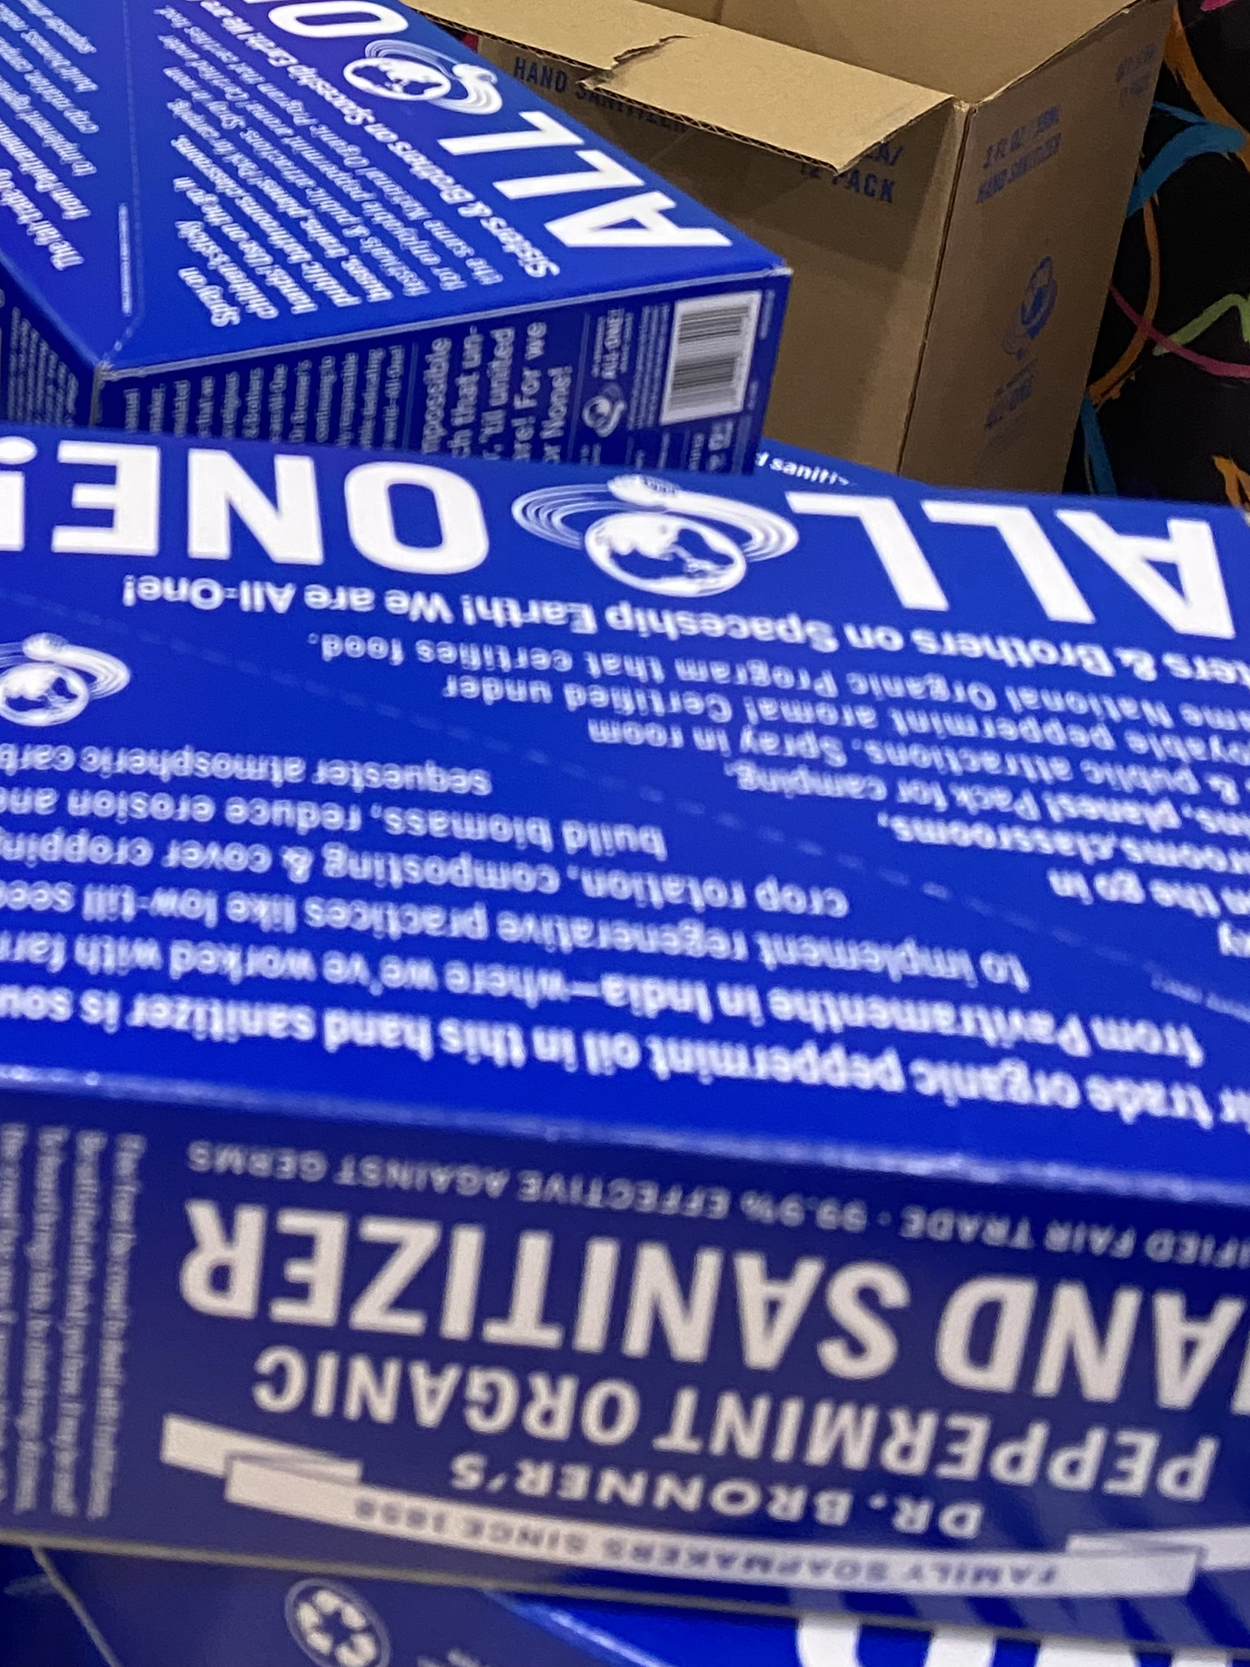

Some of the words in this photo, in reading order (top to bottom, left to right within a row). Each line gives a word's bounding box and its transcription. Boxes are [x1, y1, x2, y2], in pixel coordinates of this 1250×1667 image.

[200, 0, 233, 18] are
[221, 17, 260, 34] We
[237, 32, 298, 66] Earth!
[287, 65, 375, 125] Spaceship
[513, 56, 567, 94] HAND
[364, 124, 398, 142] on
[387, 141, 475, 204] Brothers
[438, 111, 732, 247] ALL
[458, 202, 492, 217] &
[480, 217, 560, 277] Sisters
[421, 338, 452, 454] mpossible
[786, 494, 1236, 640] ALL
[123, 575, 296, 613] All-One!
[304, 585, 375, 611] are
[385, 590, 453, 623] We
[462, 595, 597, 634] Earth!
[605, 601, 839, 652] Spaceship
[844, 624, 904, 651] on
[310, 633, 404, 665] food.
[416, 640, 573, 684] certifies
[585, 652, 665, 686] that
[911, 629, 1115, 676] Brothers
[1112, 648, 1157, 681] &
[444, 675, 552, 705] under
[675, 660, 838, 704] Program
[847, 673, 997, 714] Organic
[563, 684, 732, 723] Certified
[744, 698, 877, 732] aroma!
[1005, 687, 1173, 728] National
[588, 711, 684, 748] room
[693, 719, 730, 757] in
[735, 722, 847, 769] Spray
[890, 708, 1120, 750] peppermint
[80, 746, 306, 788] atmospheric
[312, 760, 492, 795] sequester
[852, 740, 1073, 784] attractions.
[1080, 759, 1201, 801] public
[67, 790, 215, 824] erosion
[1206, 775, 1239, 805] &
[225, 797, 362, 844] reduce
[371, 805, 553, 852] biomass,
[562, 820, 667, 861] build
[163, 840, 272, 873] cover
[281, 847, 314, 883] &
[322, 843, 560, 903] composting
[567, 866, 746, 912] rotation,
[755, 876, 849, 917] crop
[1048, 862, 1095, 905] in
[1091, 863, 1145, 903] go
[1149, 879, 1223, 917] the
[82, 884, 218, 928] low-till
[226, 892, 296, 933] like
[304, 897, 489, 940] practices
[74, 935, 163, 975] with
[497, 911, 748, 960] regenerative
[169, 940, 316, 984] worked
[323, 951, 438, 995] we've
[755, 933, 978, 988] implement
[977, 952, 1029, 992] to
[80, 990, 120, 1033] is
[445, 961, 712, 1023] India—where
[717, 984, 764, 1026] in
[126, 994, 316, 1042] sanitizer
[323, 1008, 433, 1061] hand
[767, 988, 1093, 1057] Pavitramenthe
[438, 1018, 526, 1068] this
[532, 1027, 577, 1072] in
[583, 1031, 641, 1075] oil
[1087, 1017, 1204, 1067] from
[646, 1036, 906, 1092] peppermint
[909, 1058, 1081, 1109] organic
[1085, 1075, 1213, 1129] trade
[189, 1142, 327, 1181] GERMS
[336, 1156, 509, 1198] AGAINST
[519, 1171, 730, 1219] EFFECTIVE
[741, 1192, 866, 1232] 99.9%
[901, 1207, 1031, 1249] TRADE
[1045, 1223, 1135, 1258] FAIR
[180, 1201, 909, 1379] SANITIZER
[254, 1347, 639, 1445] ORGANIC
[653, 1388, 1216, 1500] PEPPERMINT
[452, 1454, 851, 1525] BRONNER'S
[459, 1513, 588, 1560] SINCE
[870, 1495, 984, 1539] DR.
[602, 1537, 887, 1585] SOAPMAKERS
[906, 1560, 1057, 1592] FAMILY
